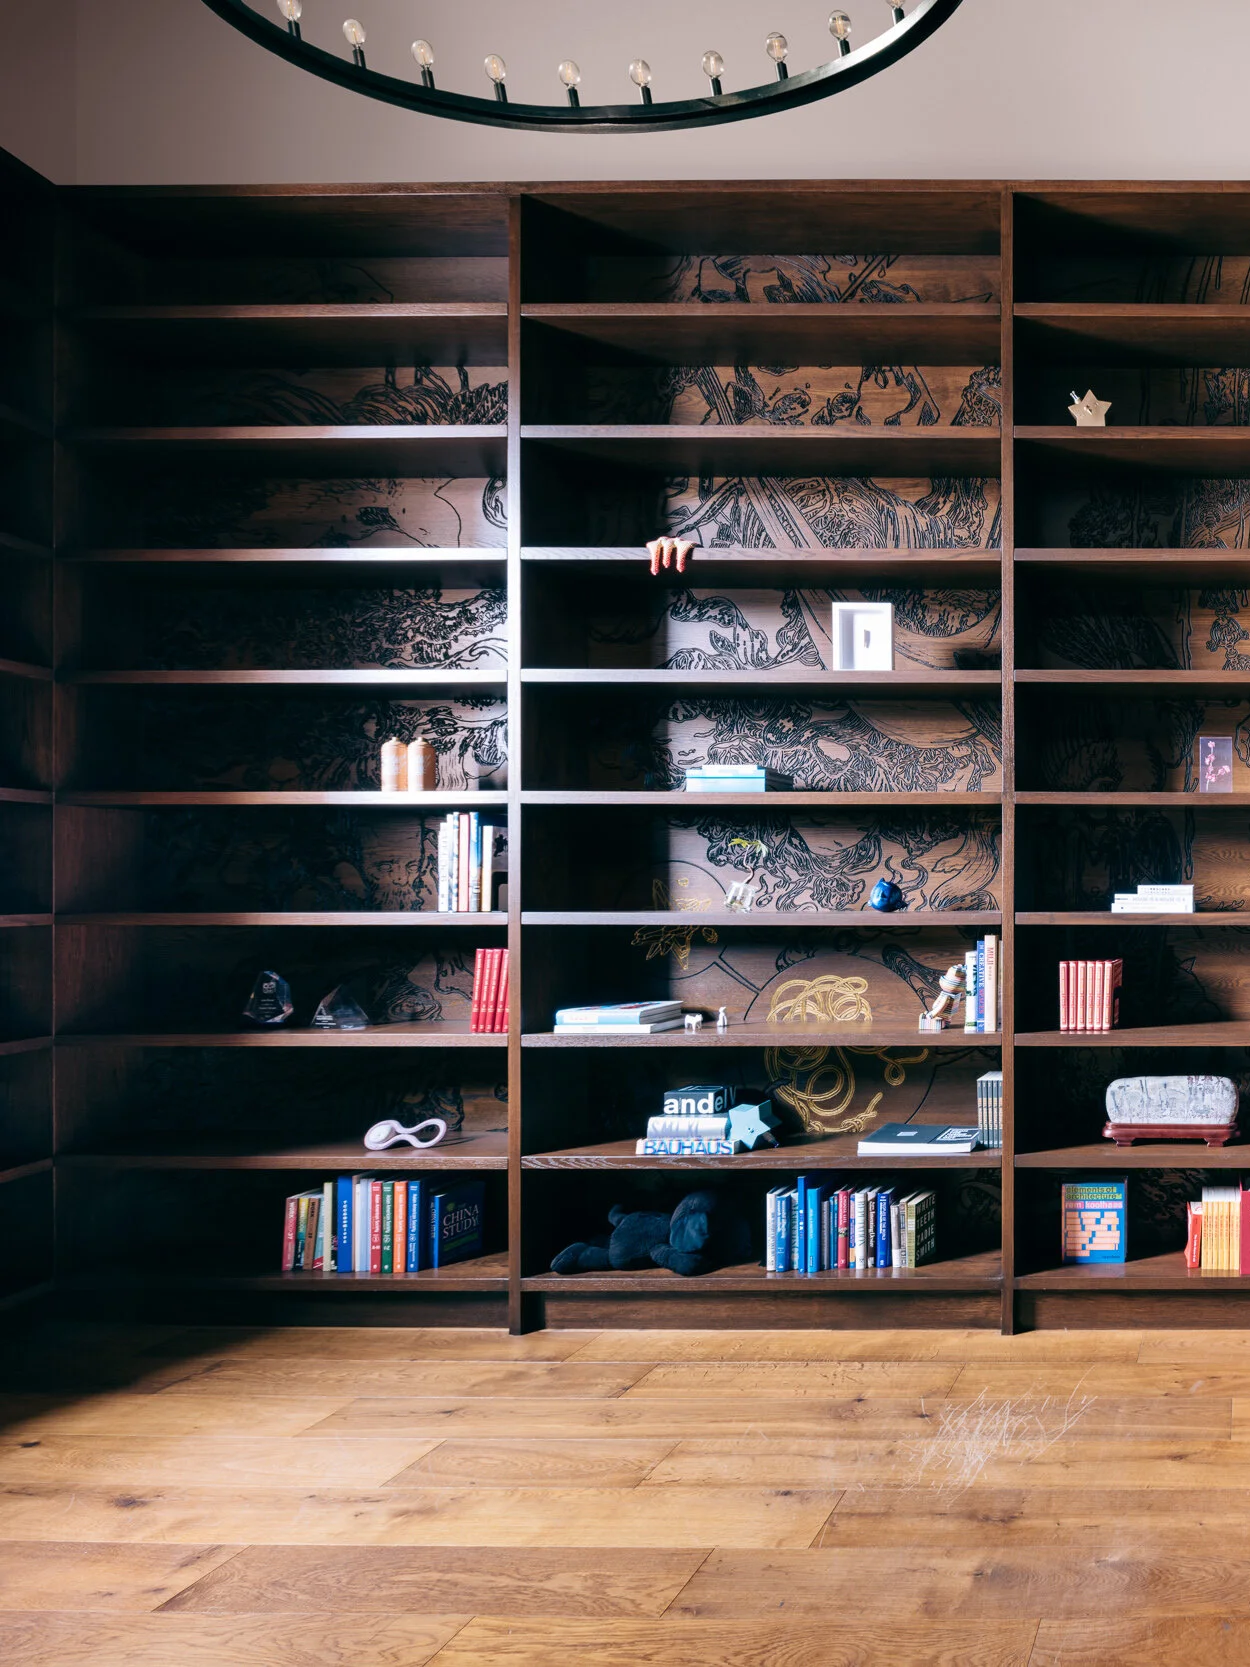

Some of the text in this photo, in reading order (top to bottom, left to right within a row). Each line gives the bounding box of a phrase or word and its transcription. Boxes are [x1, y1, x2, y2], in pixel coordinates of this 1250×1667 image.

[664, 1092, 714, 1114] and
[644, 1140, 733, 1155] BAUHAUS
[443, 1204, 479, 1226] CHINA
[916, 1194, 936, 1216] WHITE
[443, 1216, 479, 1239] STUDY
[917, 1208, 935, 1230] TEETH
[917, 1224, 934, 1246] ZADIE
[916, 1238, 934, 1260] SMITH
